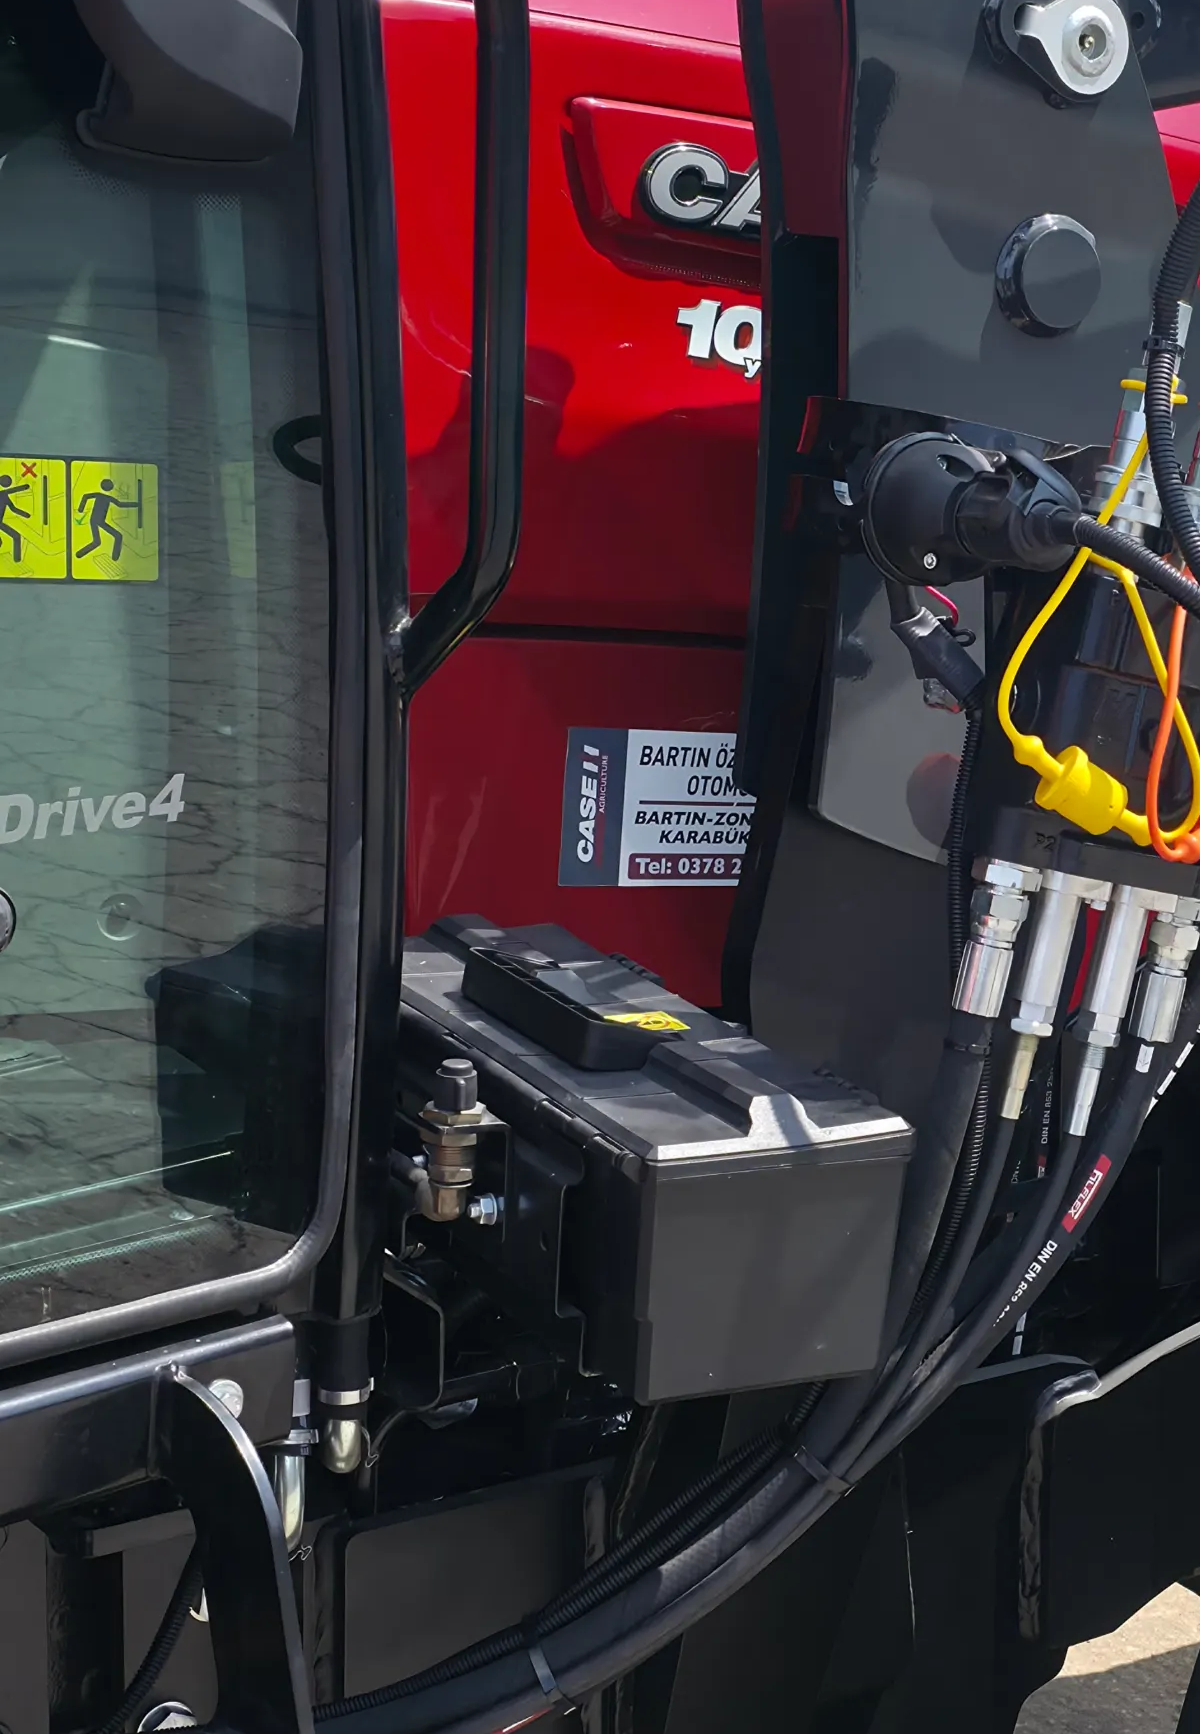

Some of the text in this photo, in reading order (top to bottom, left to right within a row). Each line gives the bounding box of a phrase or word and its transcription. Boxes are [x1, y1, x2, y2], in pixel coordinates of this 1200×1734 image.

[639, 746, 711, 767] BARTIN
[598, 755, 609, 814] AGRICULTURE
[687, 775, 749, 796] OTOM
[576, 775, 598, 863] CASE
[635, 858, 672, 874] Tel:
[678, 858, 725, 874] 0378
[1043, 1110, 1050, 1124] EN
[1040, 1126, 1049, 1144] DIN
[1037, 1239, 1058, 1264] DIN
[1024, 1261, 1042, 1282] EN
